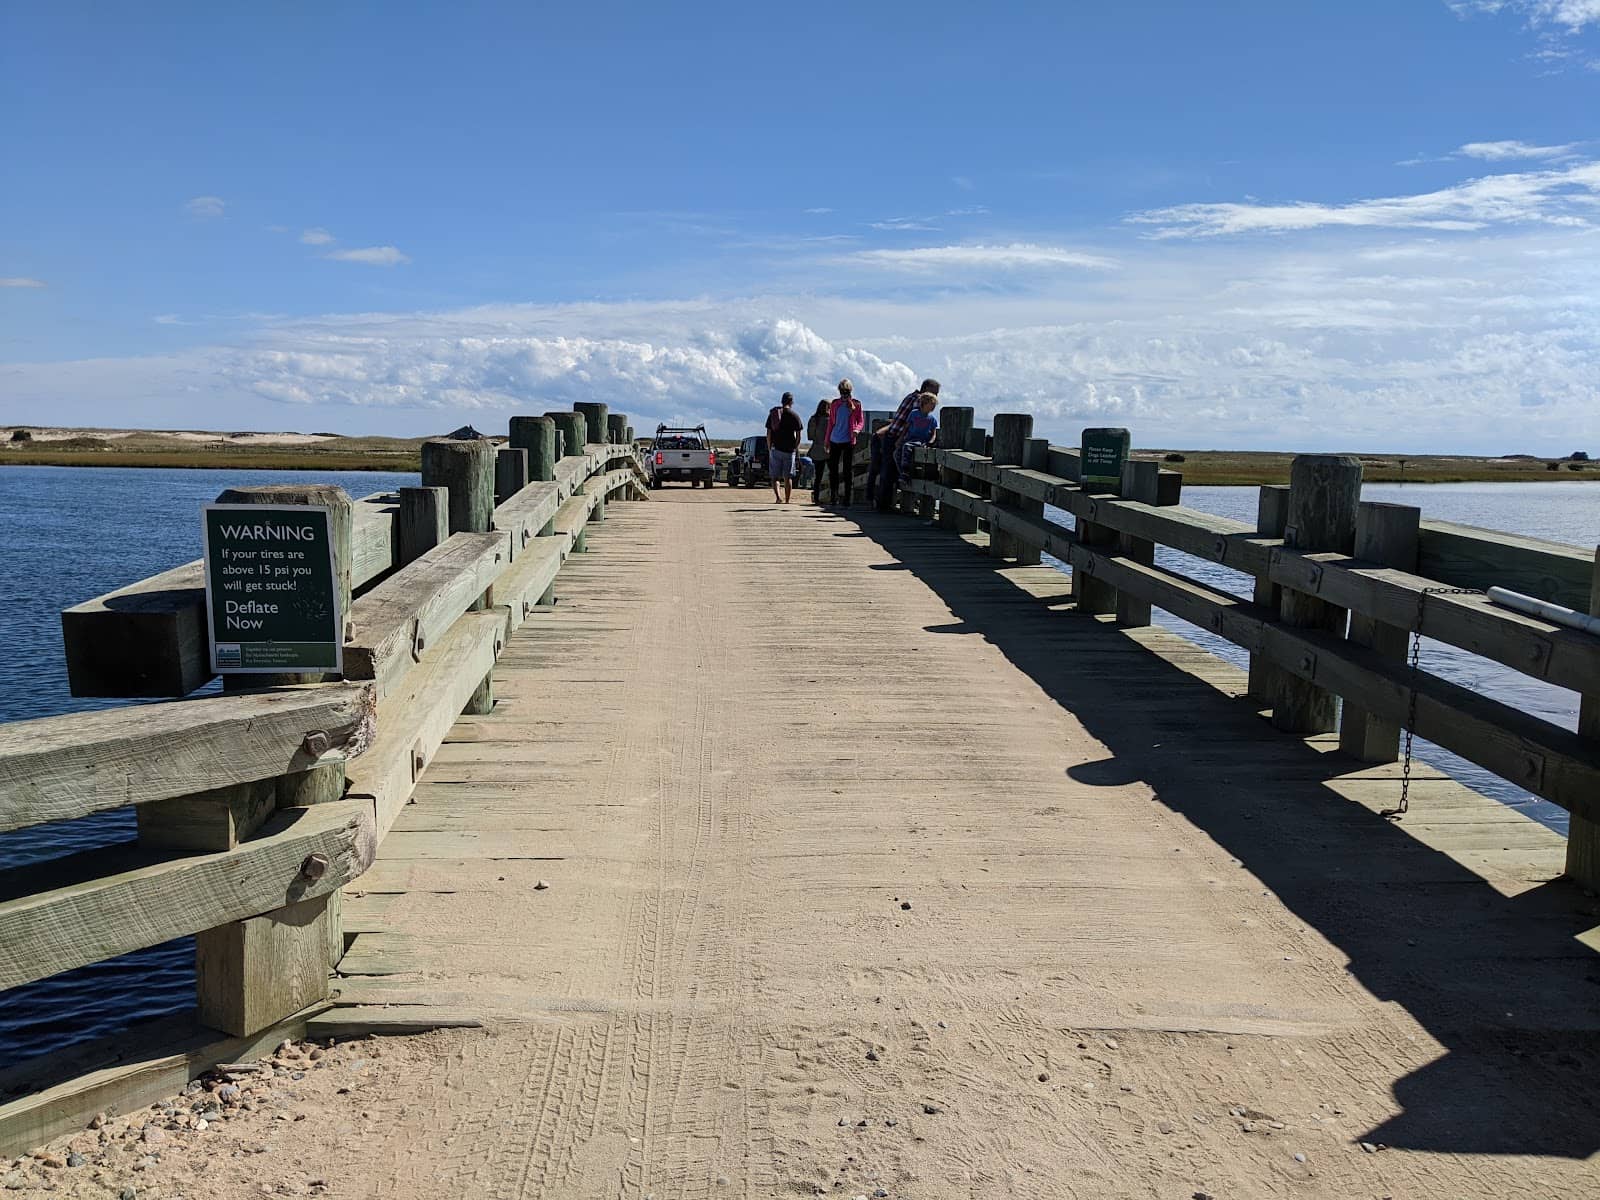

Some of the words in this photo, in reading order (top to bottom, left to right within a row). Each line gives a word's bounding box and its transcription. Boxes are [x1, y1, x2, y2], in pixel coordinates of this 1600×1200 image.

[220, 524, 315, 541] WARNING
[221, 548, 231, 559] If
[232, 550, 257, 561] your
[260, 549, 284, 559] tires
[287, 551, 305, 559] are
[222, 565, 254, 575] above
[259, 565, 271, 575] 15
[274, 565, 289, 577] psi
[292, 567, 312, 577] you
[223, 580, 242, 590] will
[245, 582, 263, 592] get
[265, 580, 297, 591] stuck!
[225, 600, 279, 614] Deflate
[226, 616, 264, 630] Now
